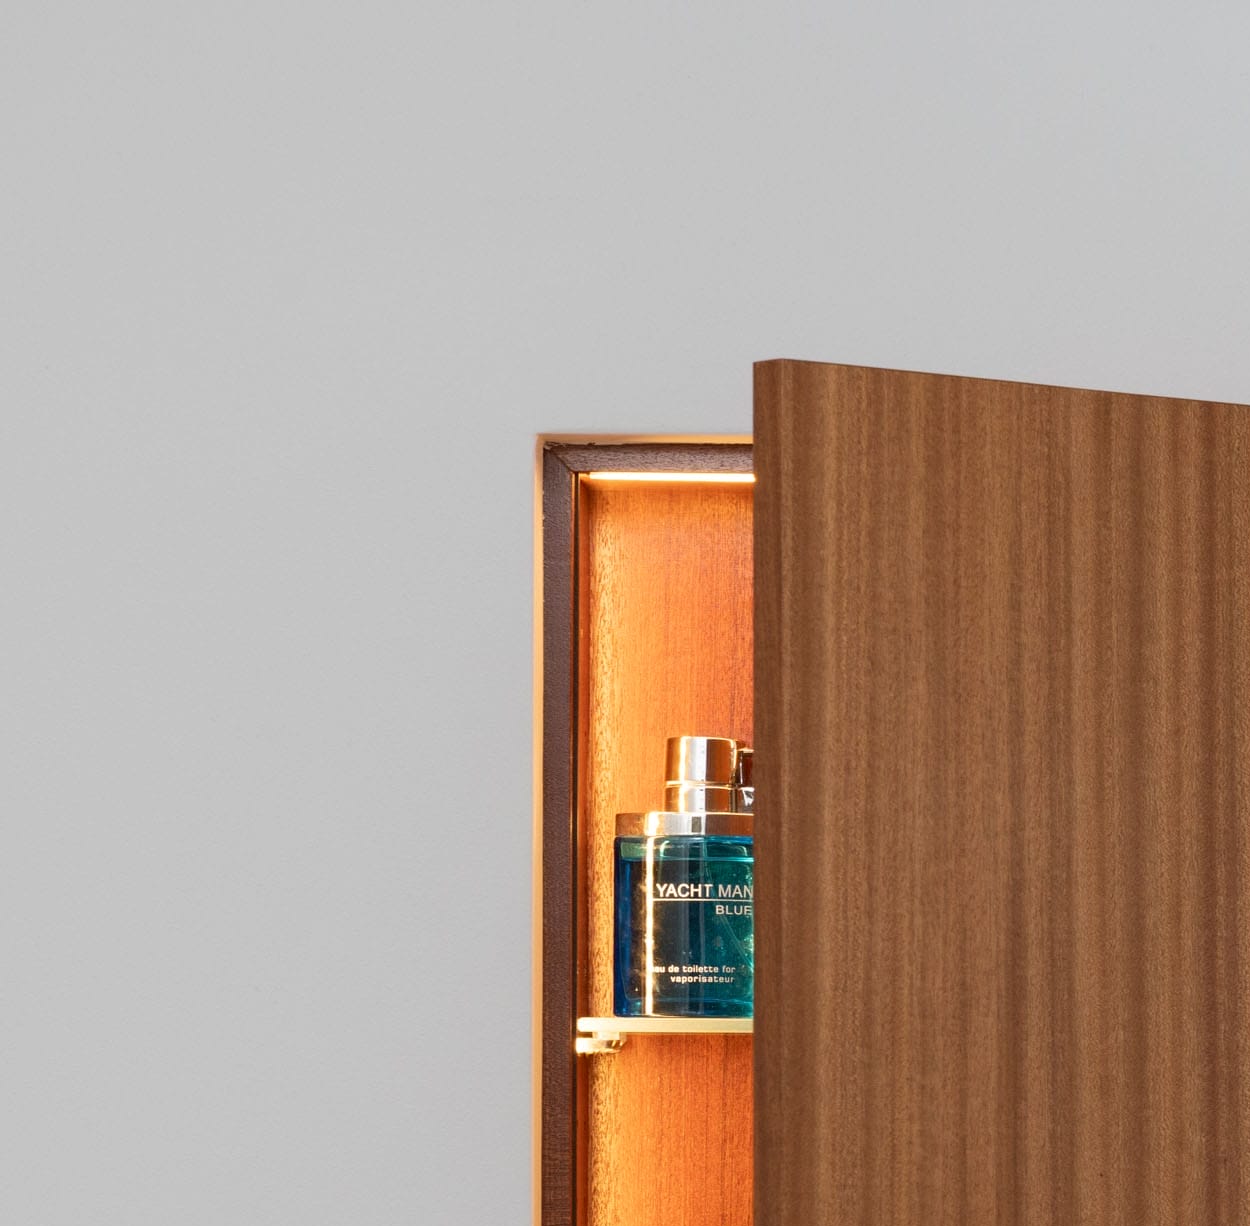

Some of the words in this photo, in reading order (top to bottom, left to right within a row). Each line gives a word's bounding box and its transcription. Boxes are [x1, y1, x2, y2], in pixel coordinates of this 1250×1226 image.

[656, 883, 713, 898] YACHT
[718, 884, 754, 898] MAN
[715, 904, 752, 915] BLUE
[668, 964, 680, 973] de
[682, 964, 719, 973] toilette
[722, 965, 736, 973] for
[670, 975, 734, 984] vaporisateur
